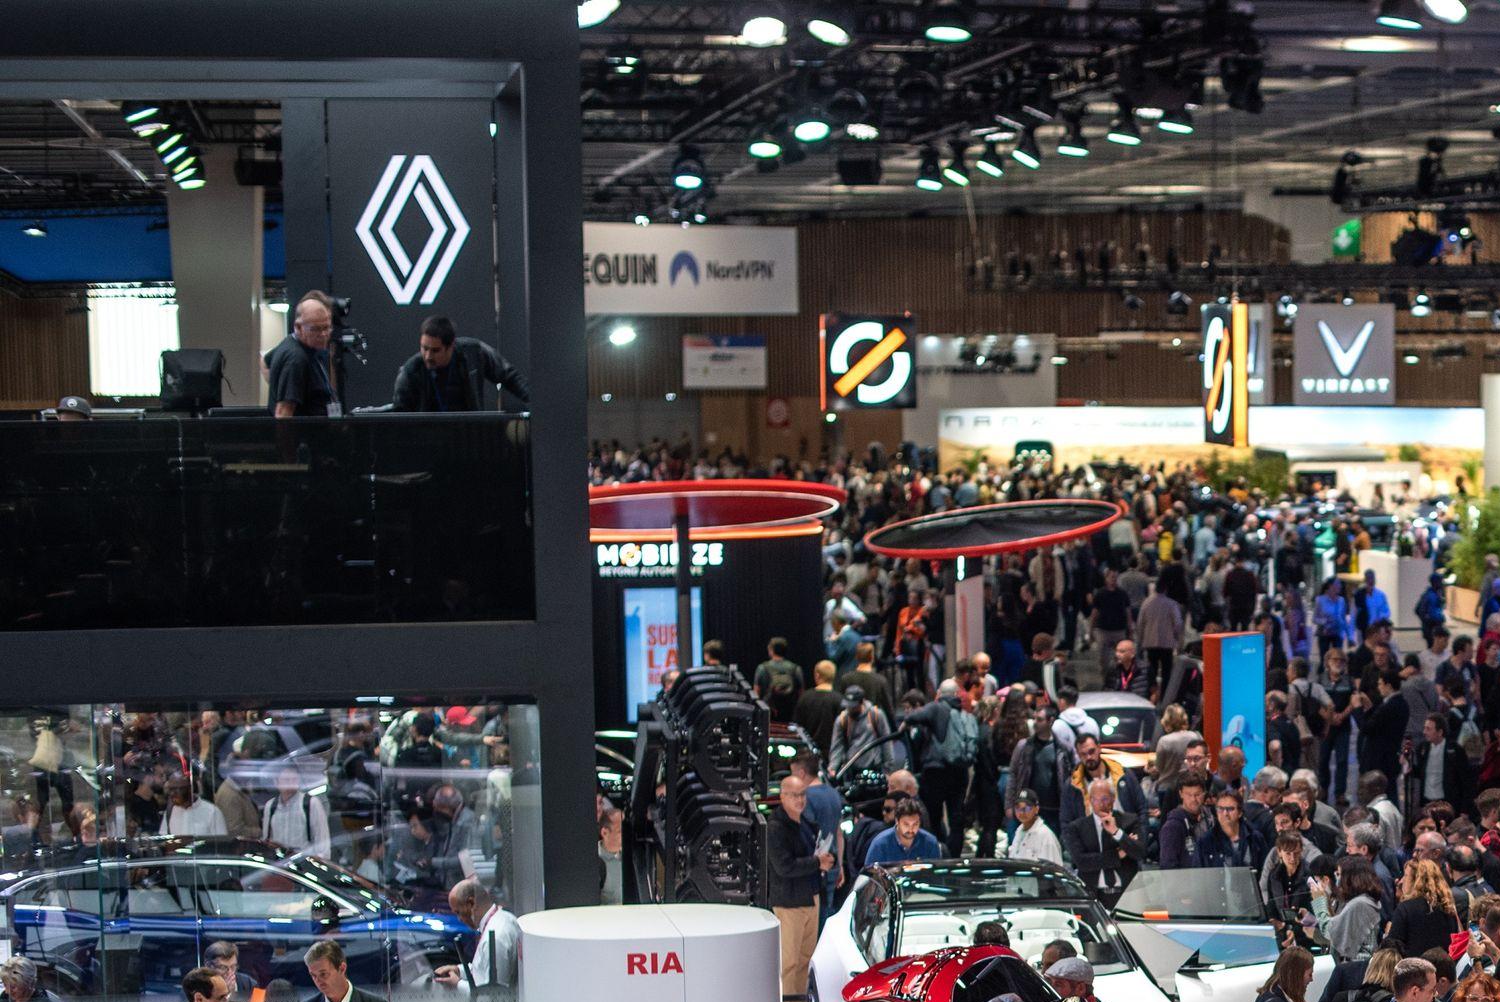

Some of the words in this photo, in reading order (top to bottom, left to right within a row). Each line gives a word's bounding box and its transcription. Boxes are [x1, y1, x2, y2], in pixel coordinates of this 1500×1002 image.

[706, 259, 774, 281] NordVPN
[597, 543, 723, 567] MOBILZE
[627, 952, 684, 975] RIA
